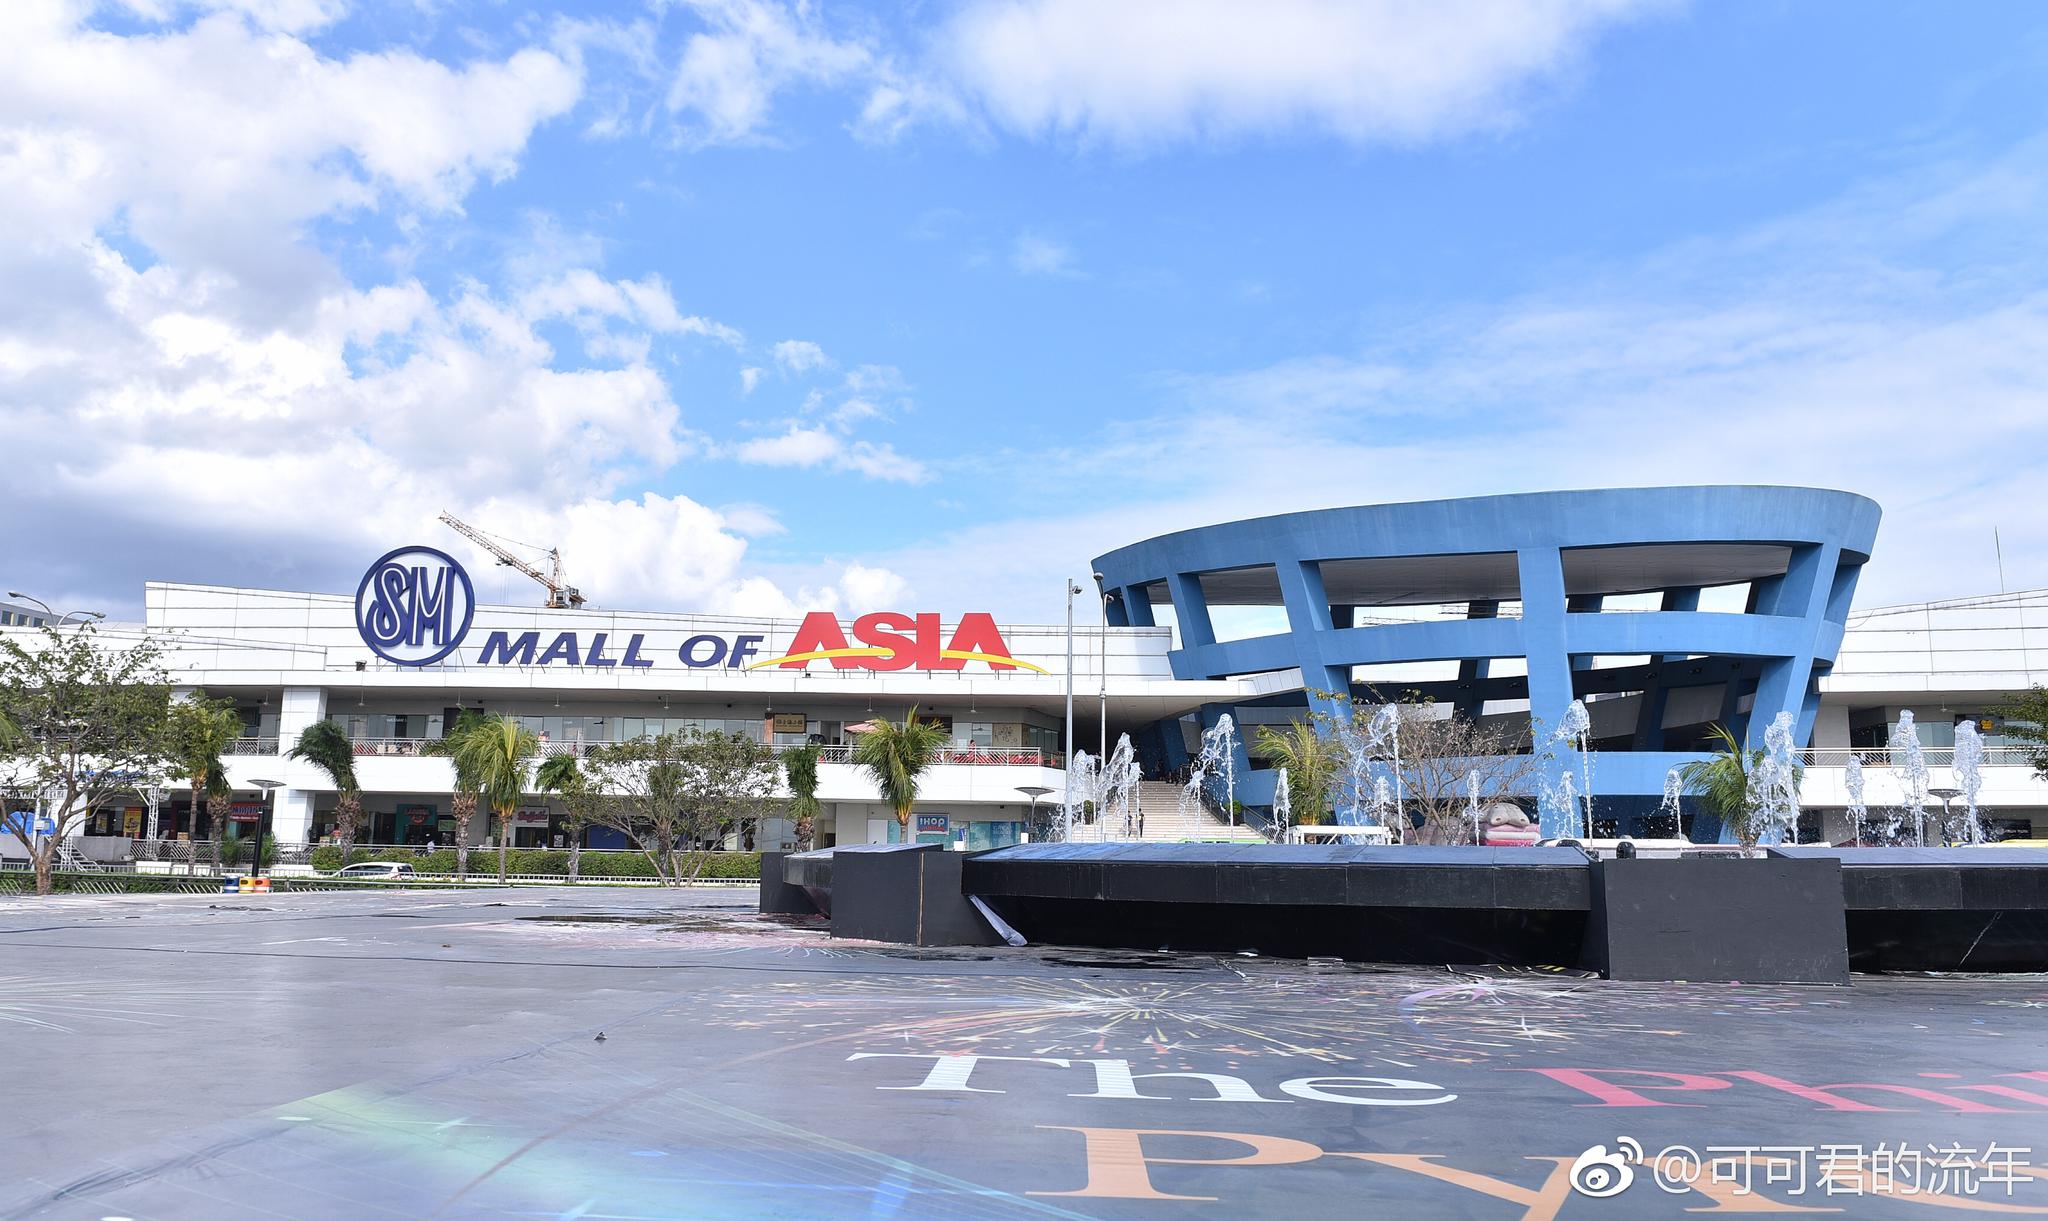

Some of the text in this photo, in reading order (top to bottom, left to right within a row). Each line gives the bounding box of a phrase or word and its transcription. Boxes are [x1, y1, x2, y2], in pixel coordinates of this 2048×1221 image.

[364, 562, 456, 647] SM
[477, 611, 1018, 672] MALL OF ASIA
[845, 1052, 2048, 1114] The Phi
